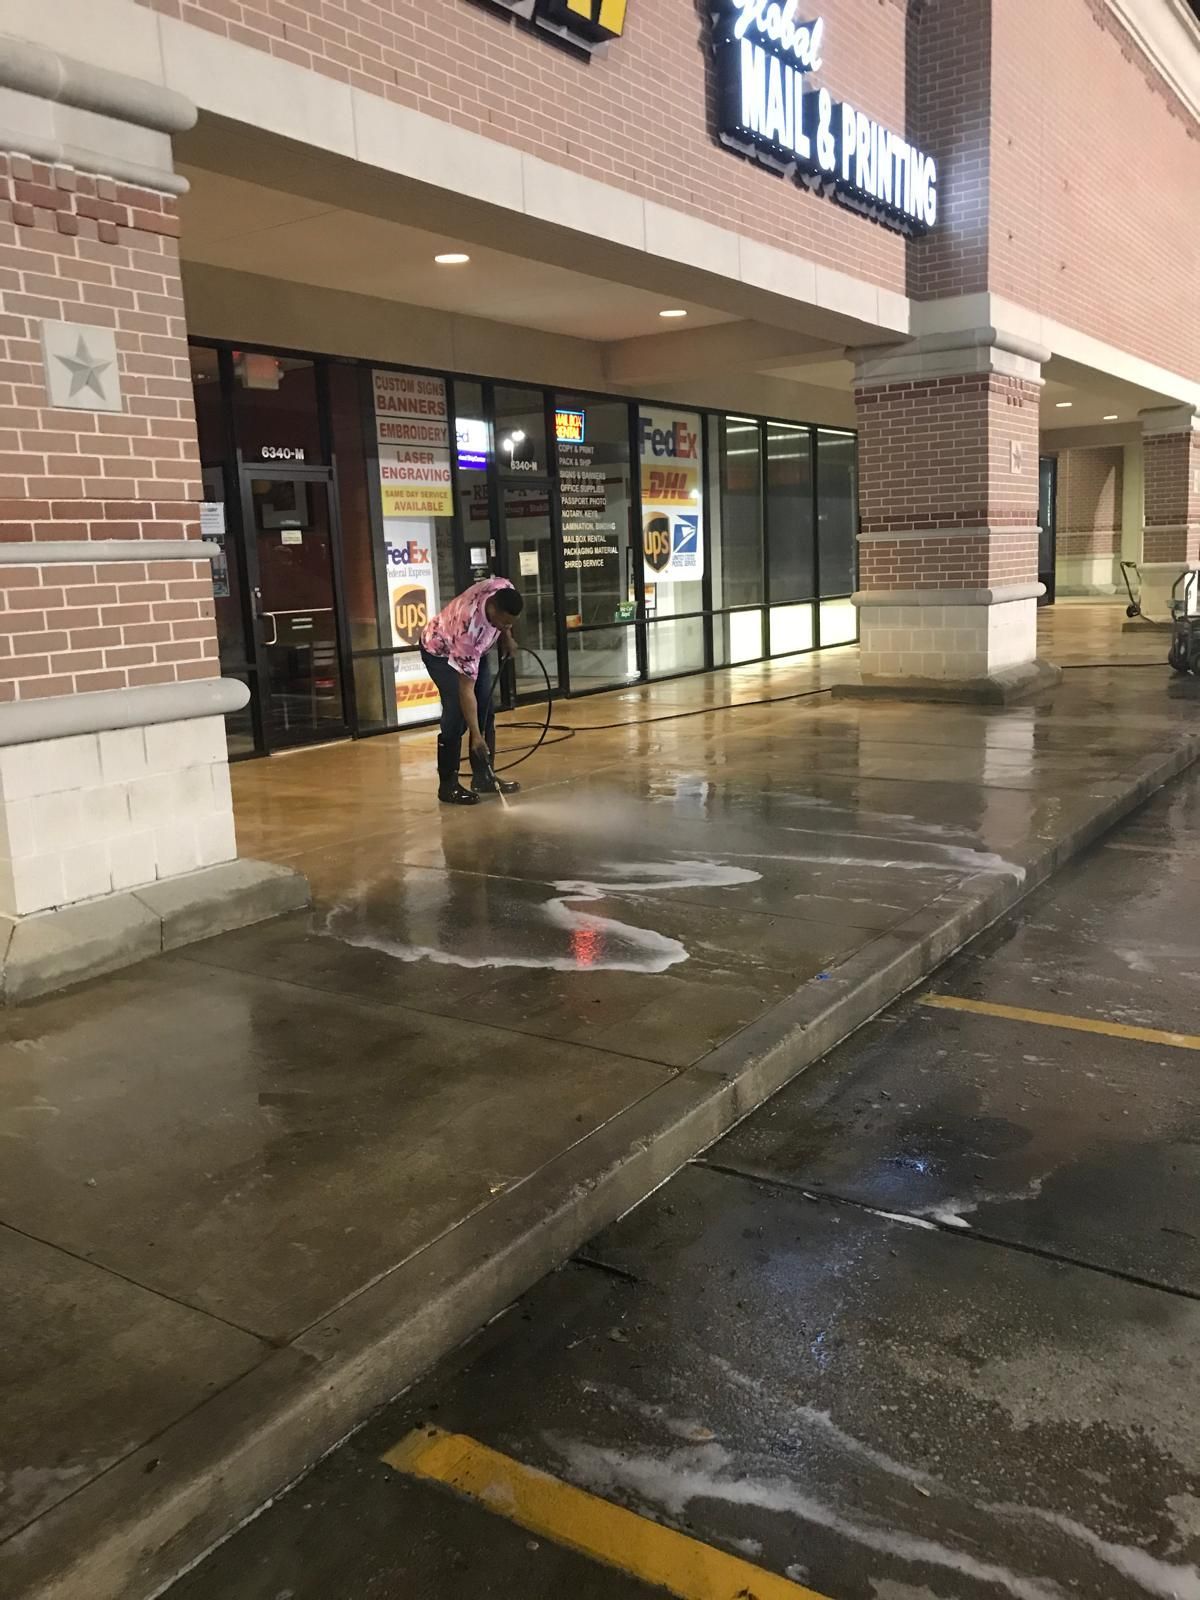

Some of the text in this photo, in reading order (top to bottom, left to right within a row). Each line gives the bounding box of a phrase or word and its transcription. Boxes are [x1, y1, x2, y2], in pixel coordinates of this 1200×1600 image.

[740, 36, 937, 227] MAIL & PRINTING
[375, 375, 445, 397] CUSTOM SIGNS
[377, 394, 446, 416] BANNERS
[379, 422, 447, 441] EMBROIDERY
[638, 417, 698, 460] FedEx
[261, 446, 305, 460] 6340-M
[559, 444, 573, 453] COPY
[579, 445, 595, 455] PRINT
[396, 450, 434, 465] LASER
[559, 457, 574, 465] PACK
[579, 458, 592, 467] SHIP
[510, 460, 538, 471] 6340-N
[381, 466, 451, 482] ENGRAVING
[560, 470, 576, 479] SIGNS
[581, 471, 606, 480] BANNERS
[560, 484, 605, 493] OFFICE SUPPLIES
[649, 471, 689, 499] DHL
[385, 490, 448, 499] SAME DAY SERVICE
[589, 497, 607, 505] PHOTO
[394, 501, 444, 512] AVAILABLE
[563, 535, 607, 543] MAILBOX RENTAL
[385, 541, 430, 565] FedEx
[563, 546, 619, 556] PACKAGING MATERIAL
[644, 530, 669, 564] ups
[564, 559, 605, 569] SHRED SERVICE
[396, 603, 427, 638] ups
[395, 681, 439, 702] DHL
